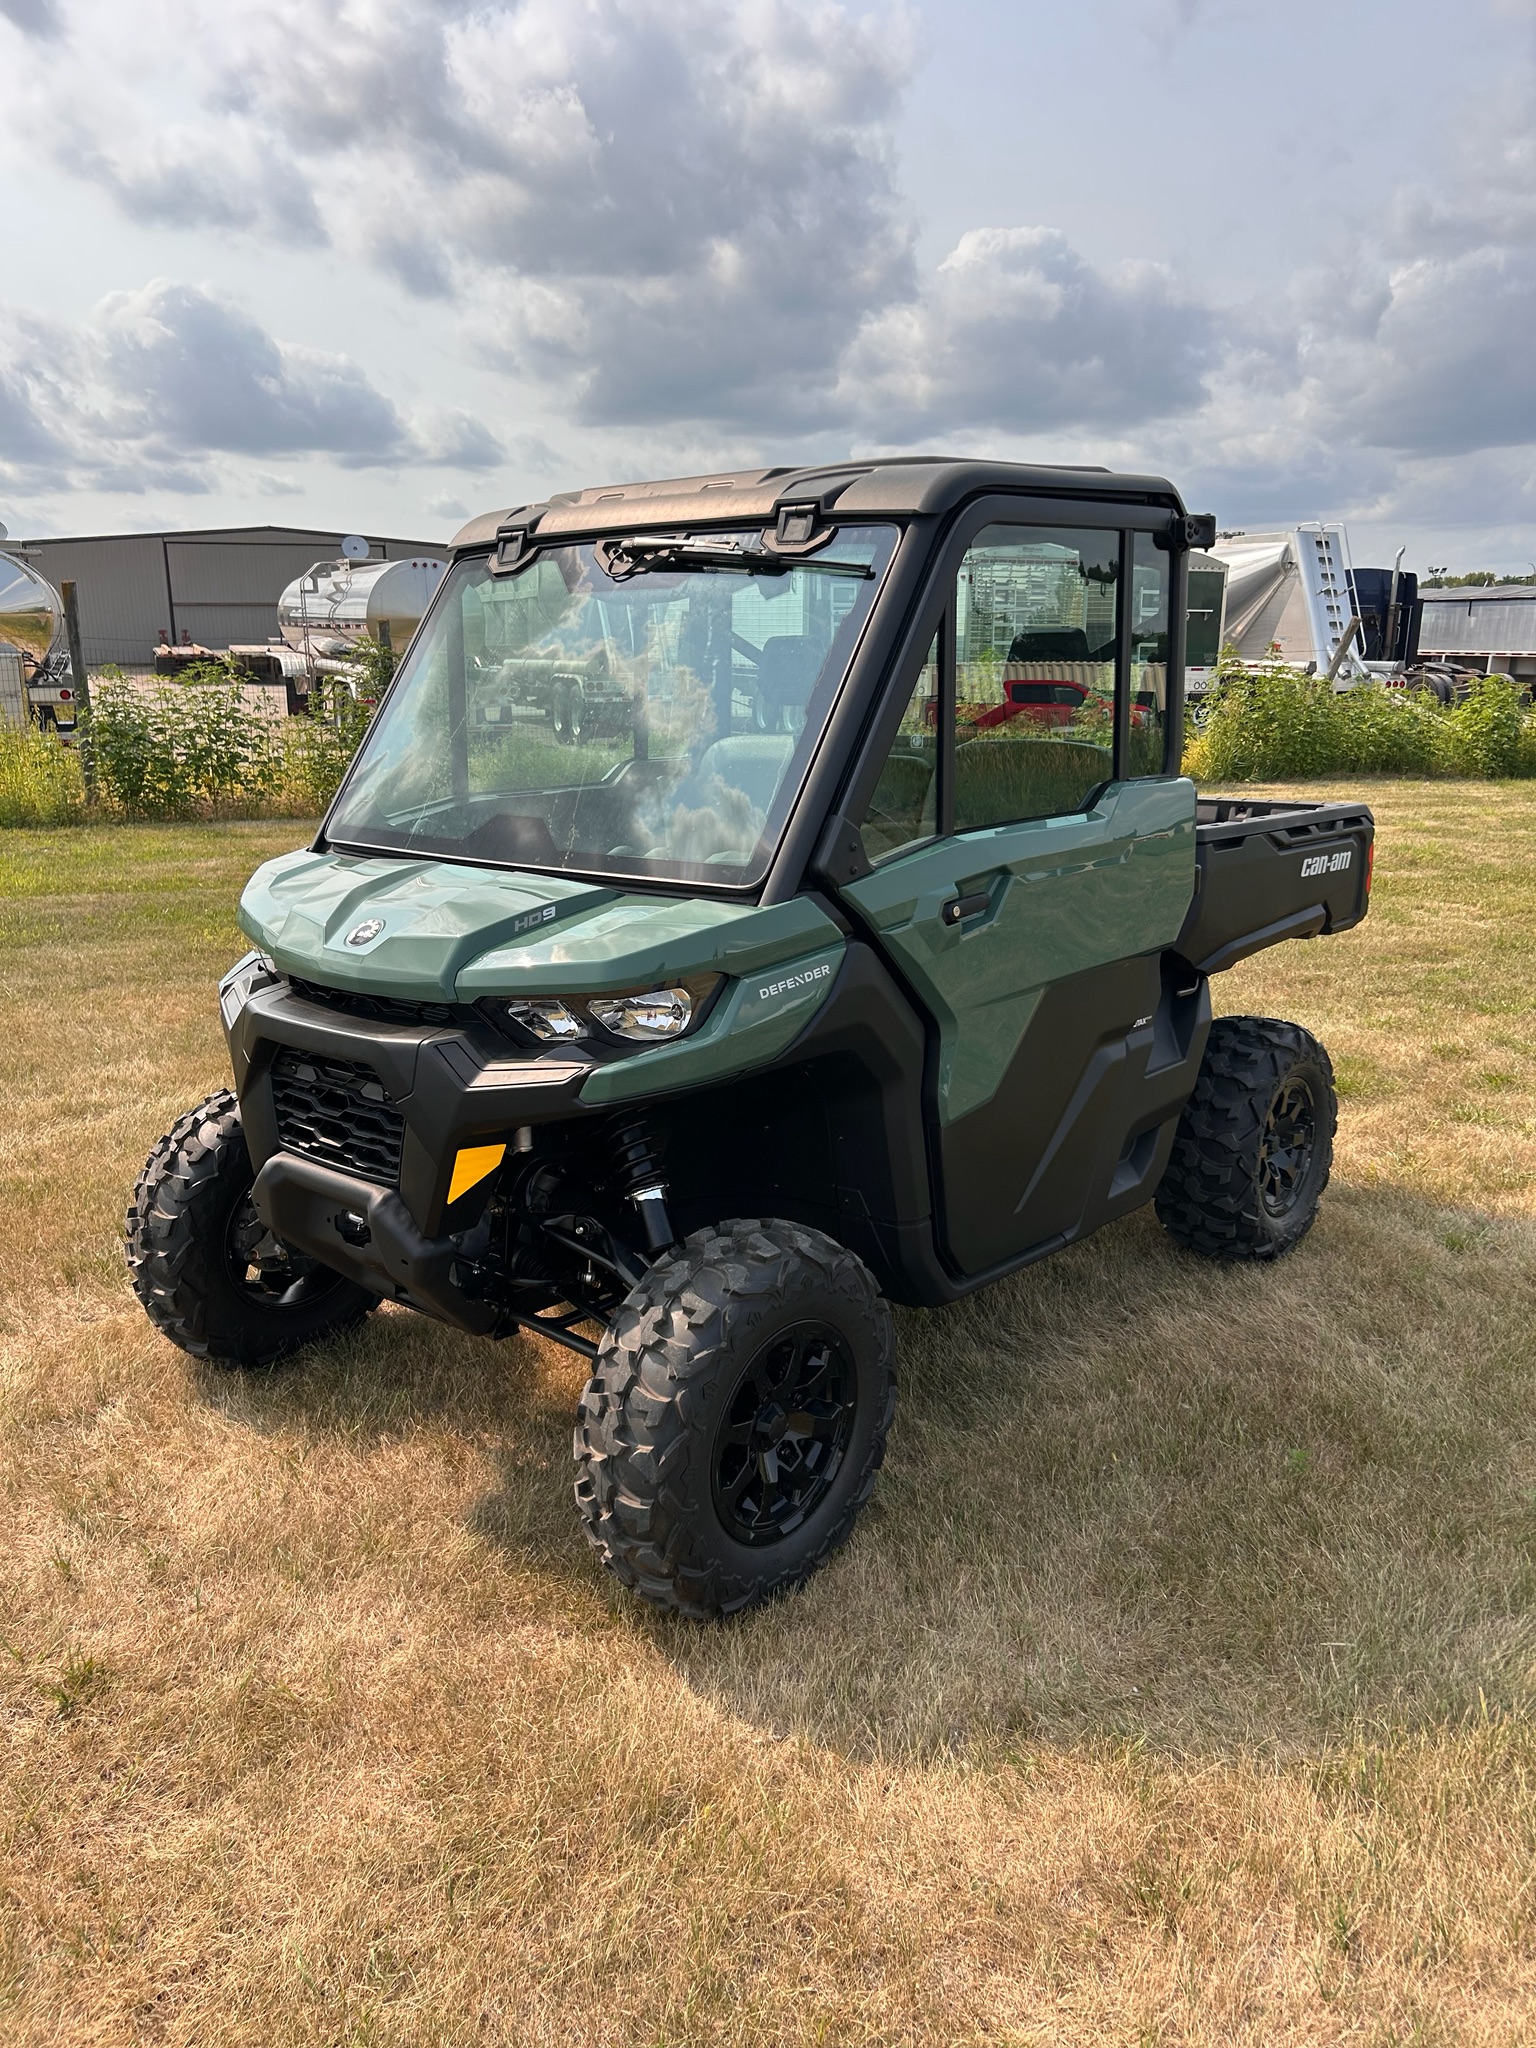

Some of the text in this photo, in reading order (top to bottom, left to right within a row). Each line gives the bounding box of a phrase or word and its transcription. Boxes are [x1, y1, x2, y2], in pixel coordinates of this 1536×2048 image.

[1301, 851, 1352, 877] can-am
[514, 906, 556, 932] HD9
[759, 965, 830, 1000] DEFENDER
